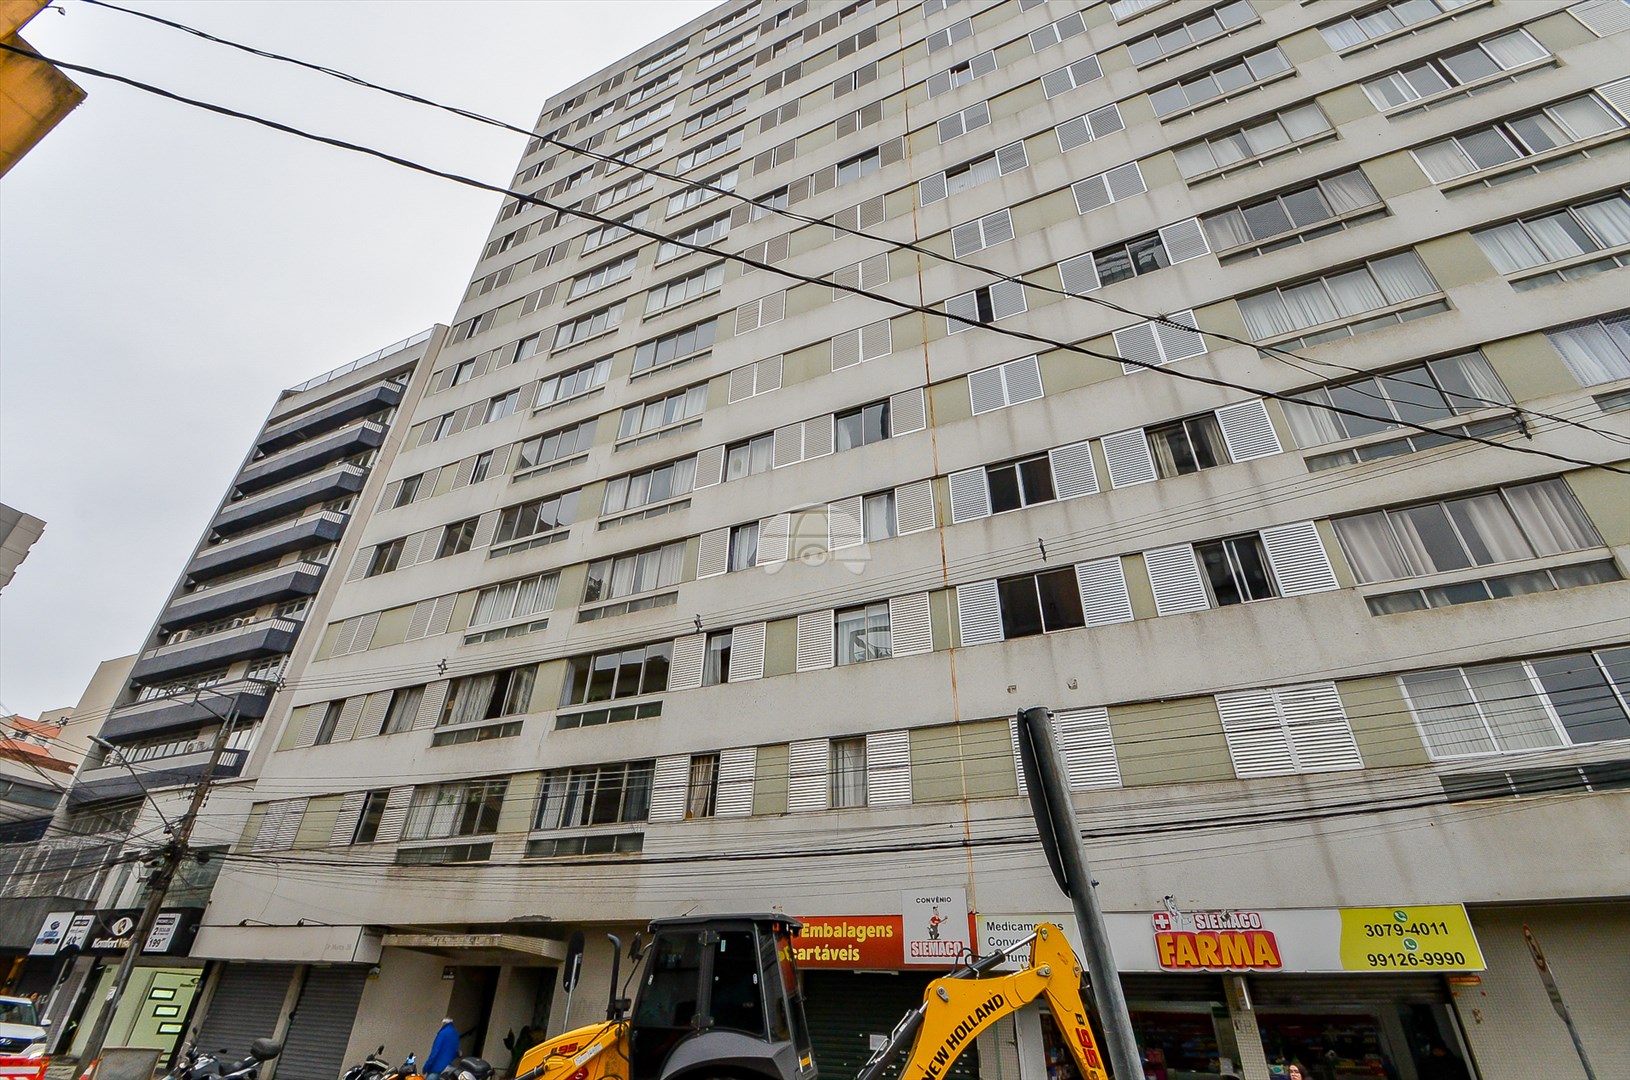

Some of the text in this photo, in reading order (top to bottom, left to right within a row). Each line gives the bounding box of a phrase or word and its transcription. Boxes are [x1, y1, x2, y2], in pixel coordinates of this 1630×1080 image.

[1196, 913, 1261, 929] SIEMACO
[801, 922, 893, 942] Embalagens
[1364, 922, 1449, 937] 3079-4011
[911, 941, 963, 957] SIEMACO
[1158, 934, 1278, 966] FARMA
[1367, 951, 1466, 967] 99126-9990
[946, 994, 1005, 1051] HOLLAND
